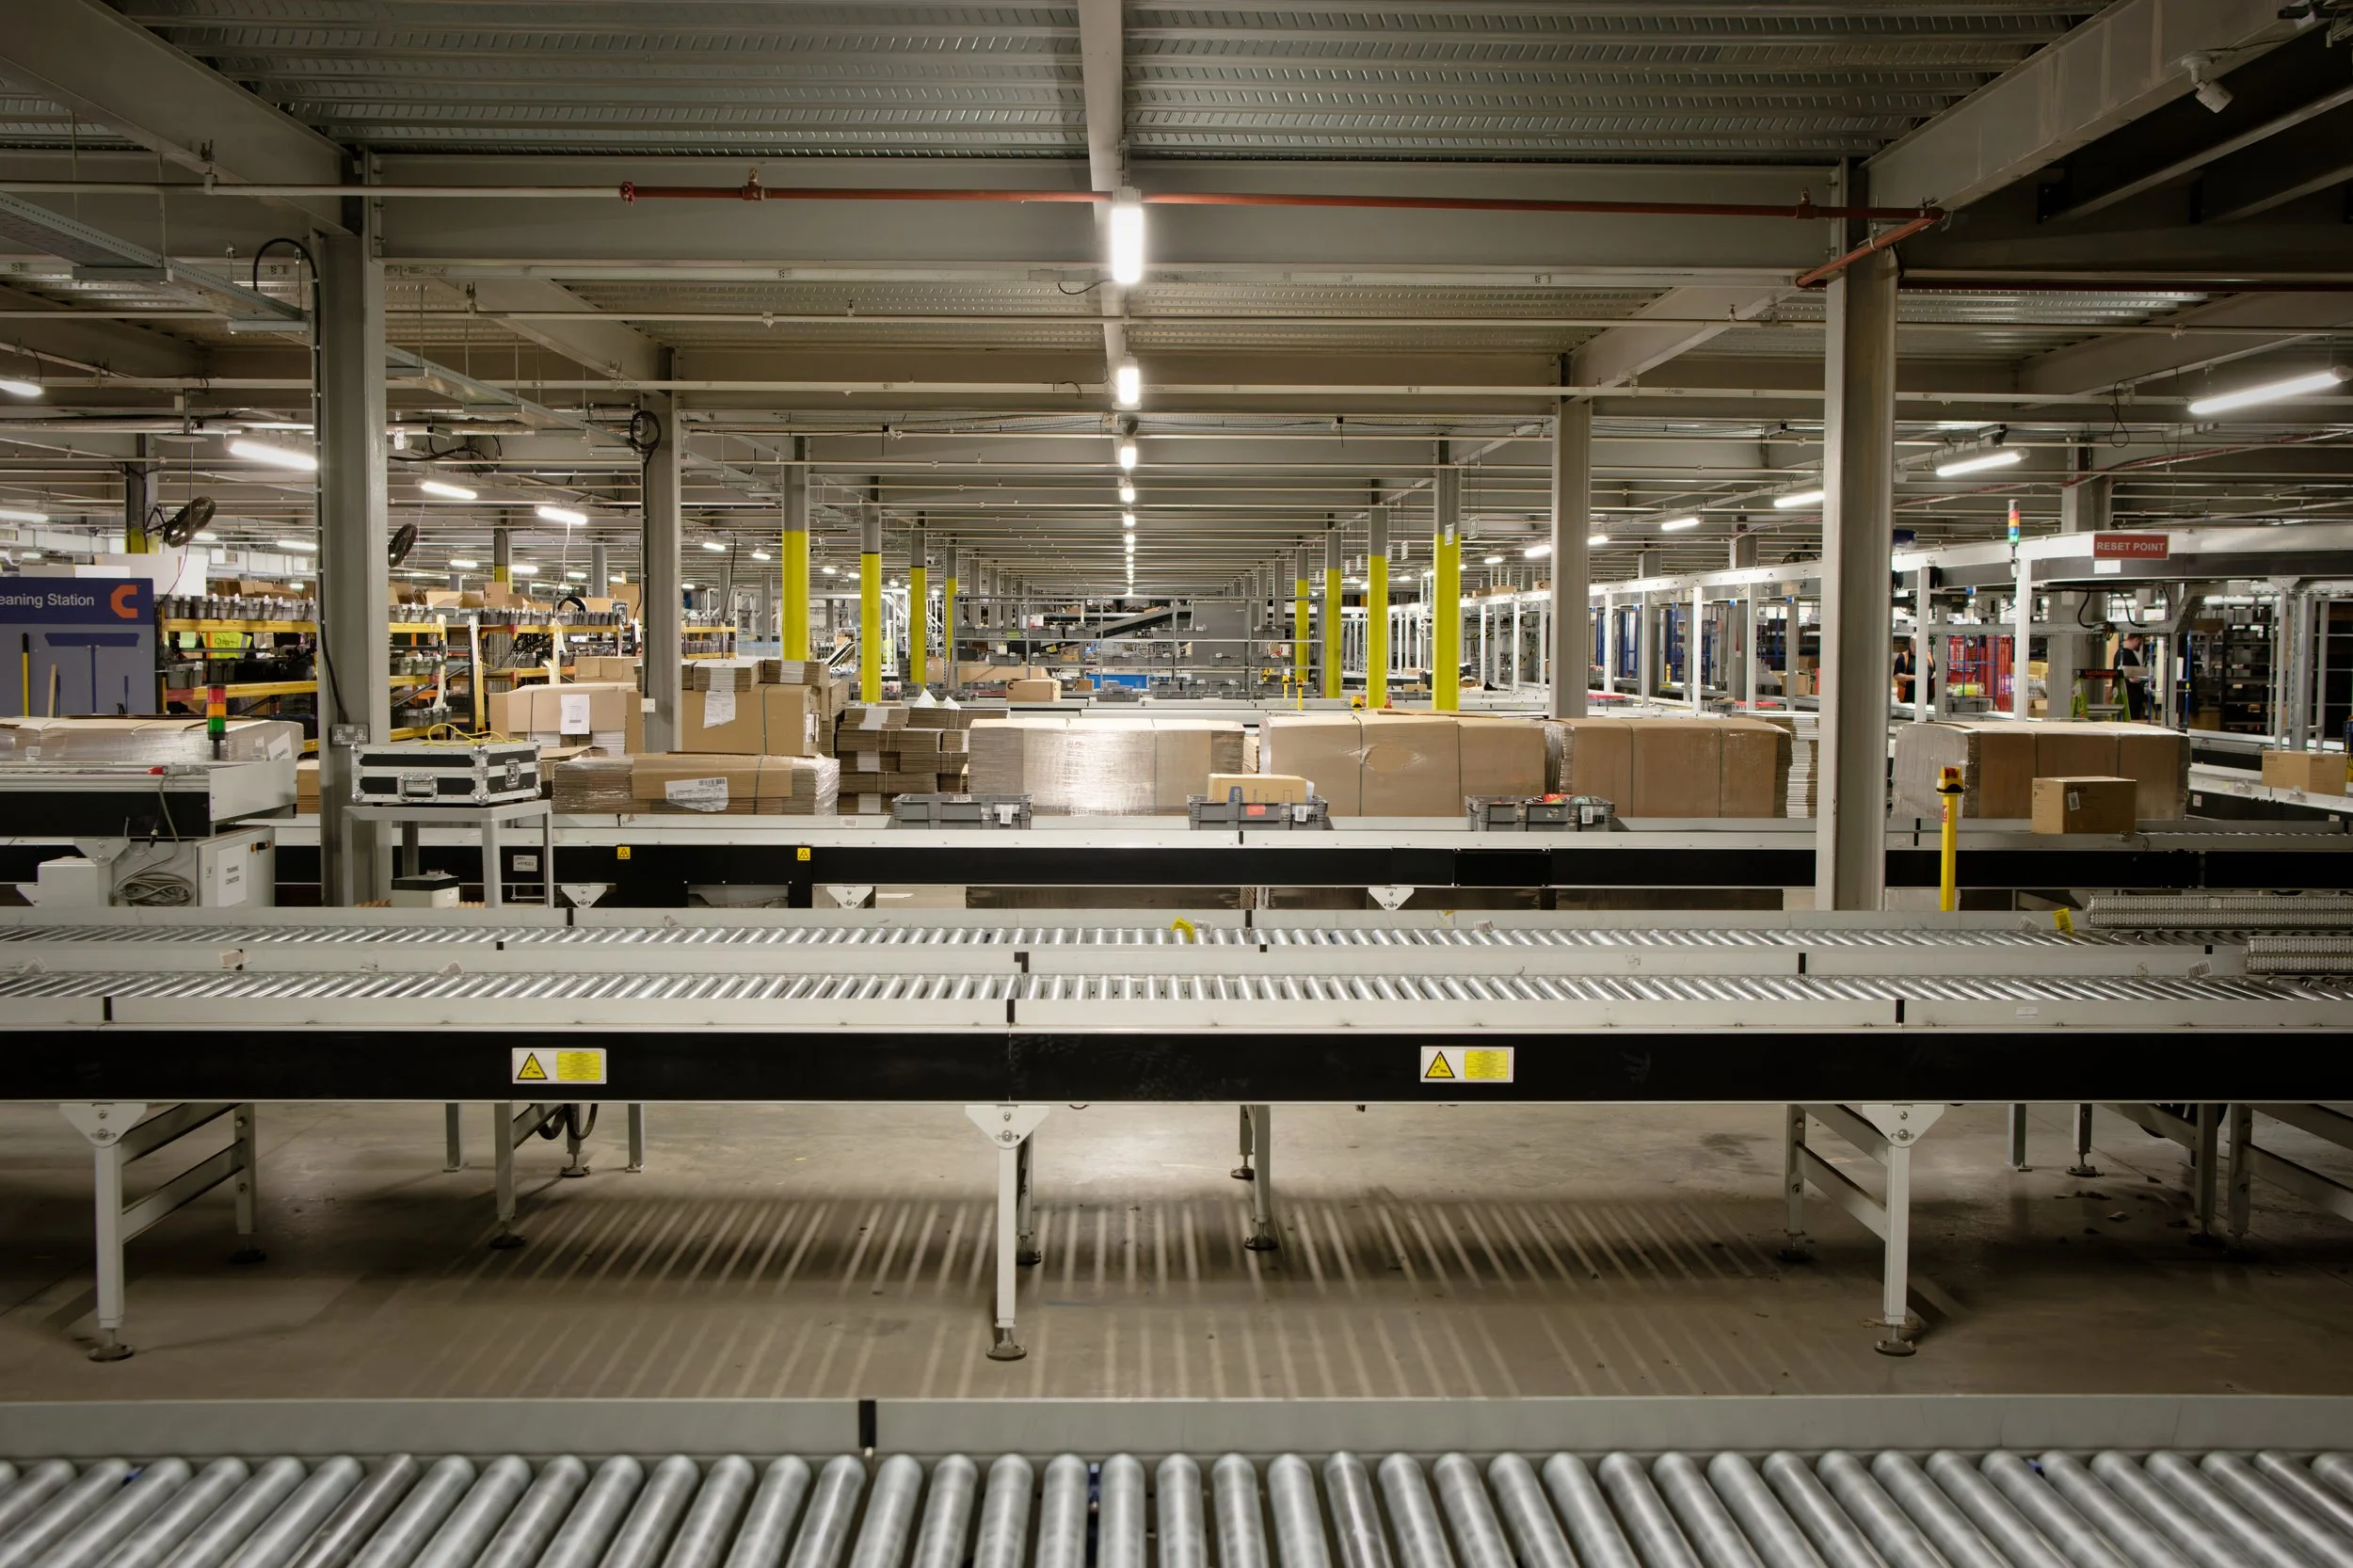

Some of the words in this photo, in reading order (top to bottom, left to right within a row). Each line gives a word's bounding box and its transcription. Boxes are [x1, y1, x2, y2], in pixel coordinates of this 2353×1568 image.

[2096, 541, 2131, 551] RESET
[2133, 542, 2165, 552] POINT
[47, 593, 94, 606] Station
